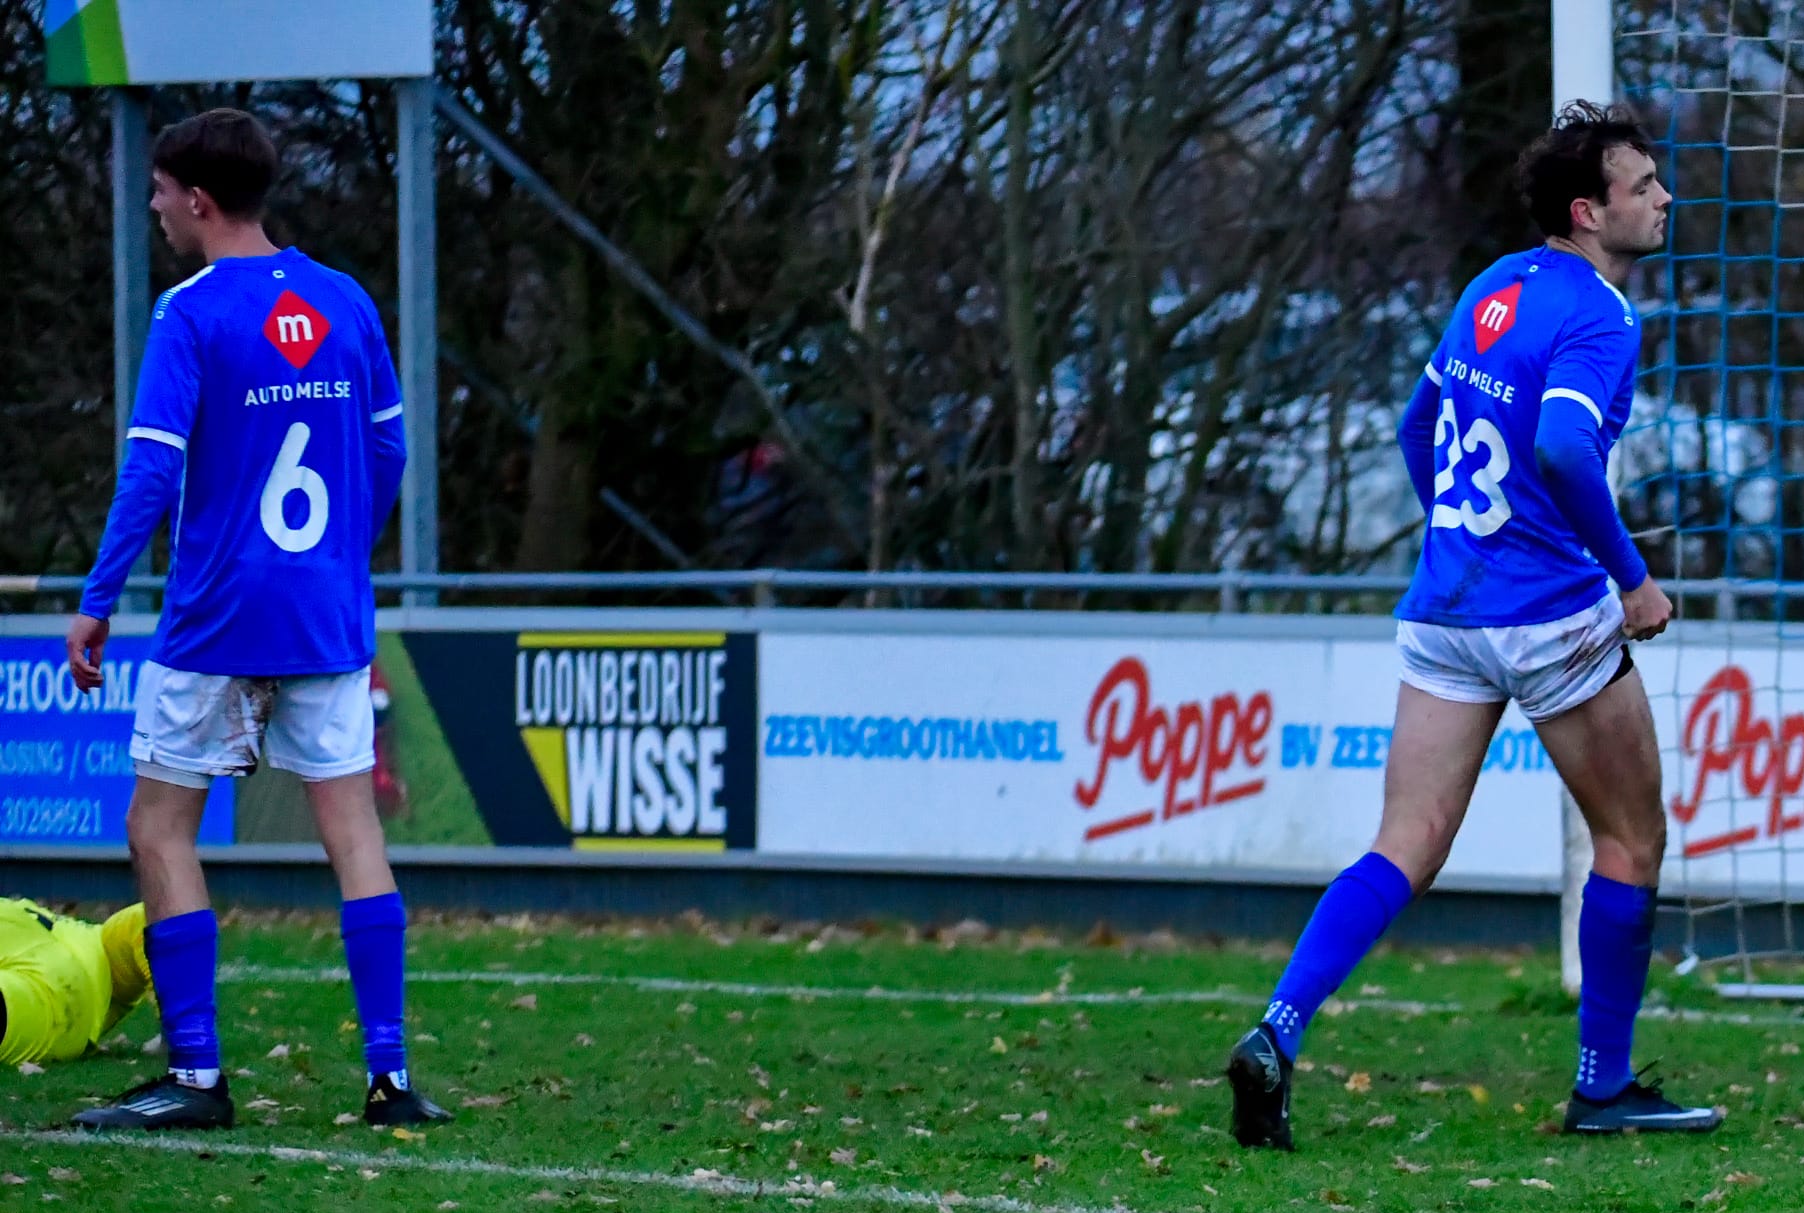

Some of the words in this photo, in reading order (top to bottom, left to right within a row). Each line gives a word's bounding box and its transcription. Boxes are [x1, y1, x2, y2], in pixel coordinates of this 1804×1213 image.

[276, 313, 314, 343] m
[244, 385, 293, 406] AUTO
[296, 381, 351, 399] MELSE
[1468, 367, 1515, 404] MELSE
[260, 421, 329, 553] 6
[1431, 398, 1512, 537] 23
[515, 650, 727, 726] LOONBEDRIJF
[566, 726, 727, 835] WISSE
[765, 714, 1065, 762] ZEEVISGROOTHANDEL
[1073, 655, 1273, 823] Poppe
[1281, 724, 1322, 769] BV
